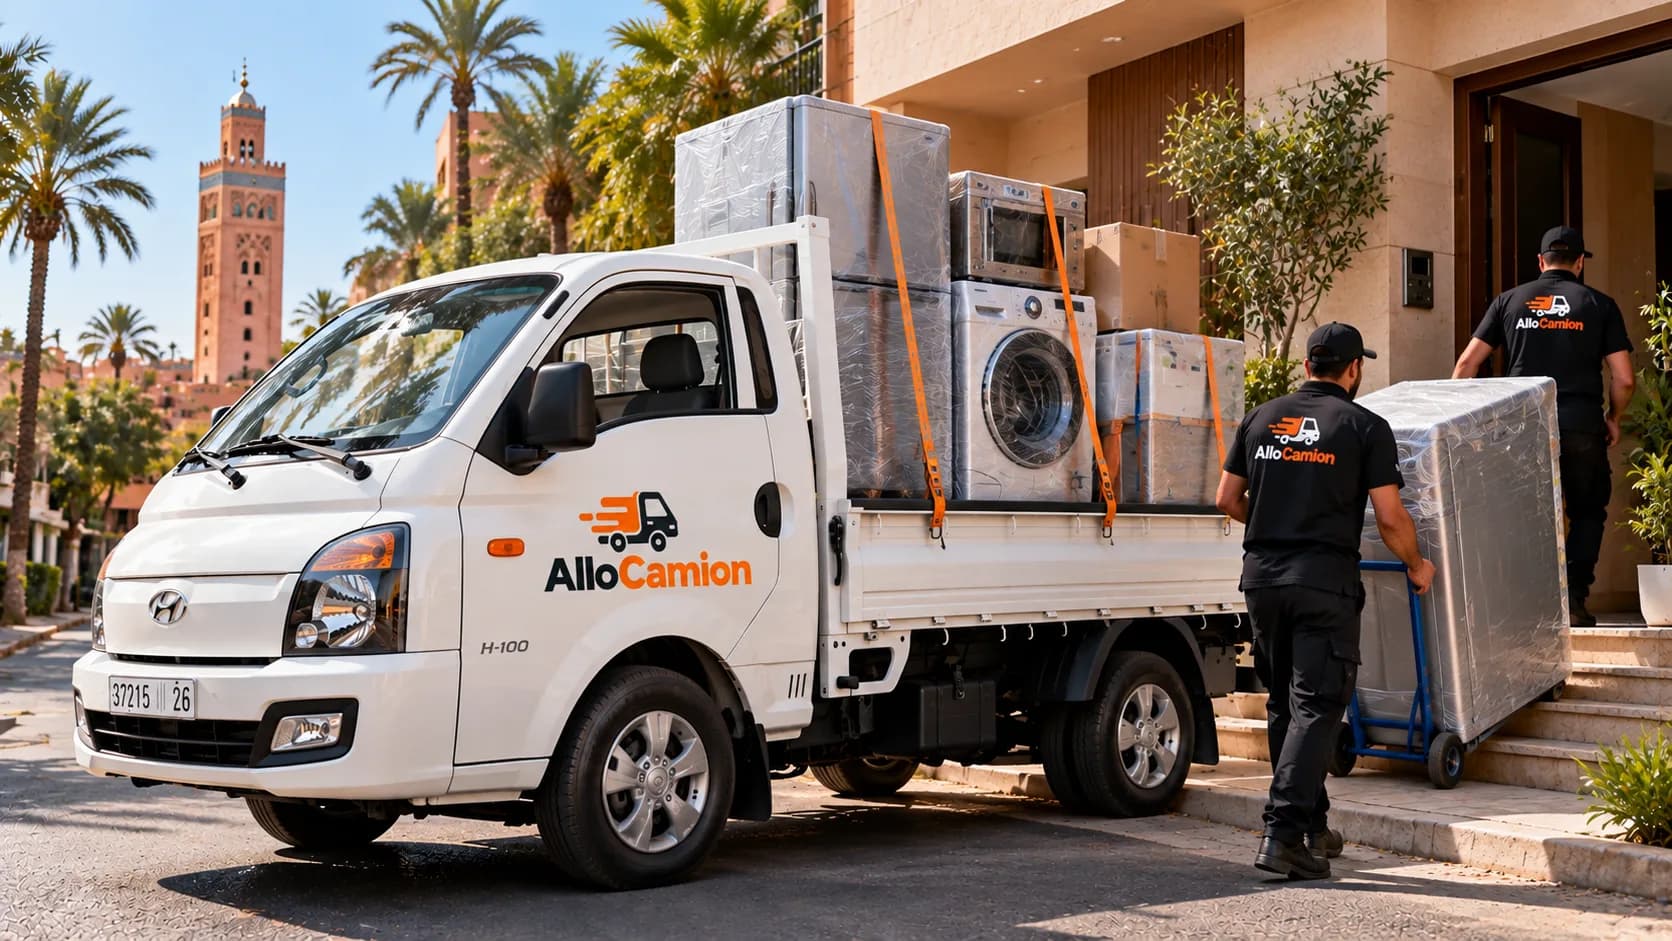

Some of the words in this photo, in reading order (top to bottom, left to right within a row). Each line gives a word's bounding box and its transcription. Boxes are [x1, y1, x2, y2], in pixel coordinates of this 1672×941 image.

[1515, 317, 1584, 331] AlloCamion
[1254, 445, 1336, 465] AlloCamion
[544, 551, 752, 592] AlloCamion
[480, 640, 529, 655] H-100
[112, 683, 150, 708] 37215
[173, 686, 190, 711] 26
